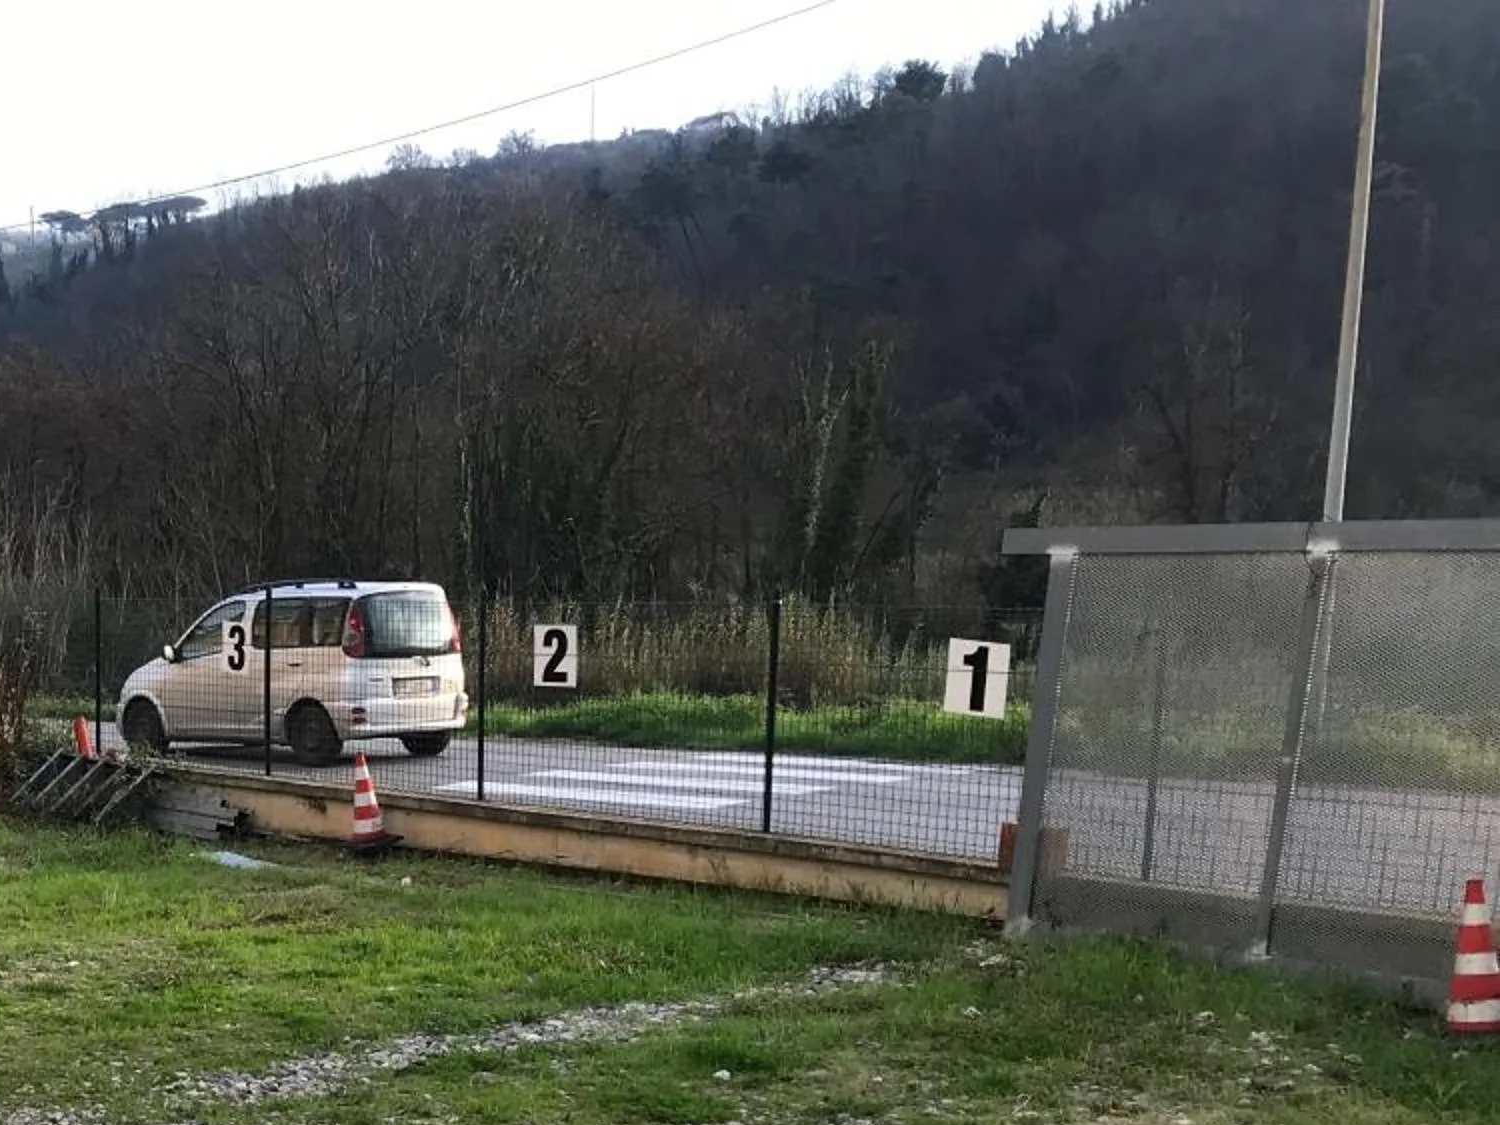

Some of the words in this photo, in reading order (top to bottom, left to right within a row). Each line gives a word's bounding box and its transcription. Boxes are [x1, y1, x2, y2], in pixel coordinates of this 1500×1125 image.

[228, 625, 246, 671] 3
[542, 628, 568, 683] 2
[963, 645, 990, 712] 1
